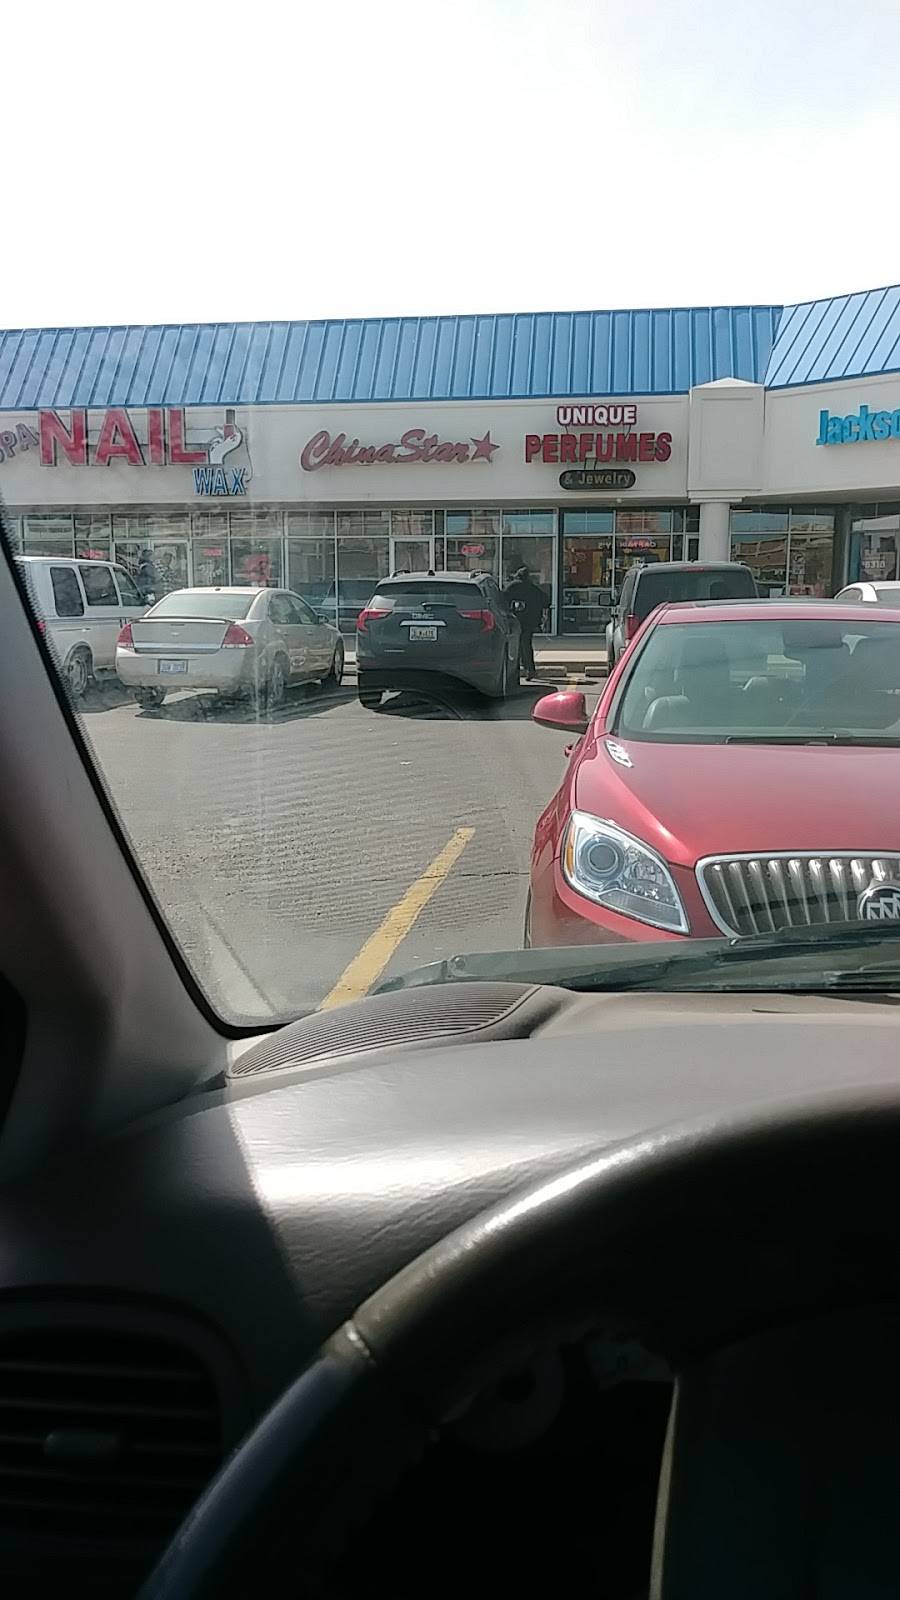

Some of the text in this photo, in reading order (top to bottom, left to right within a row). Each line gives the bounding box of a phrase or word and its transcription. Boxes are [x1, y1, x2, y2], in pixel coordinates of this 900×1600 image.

[557, 405, 638, 426] UNIQUE
[38, 408, 209, 466] NAIL
[525, 432, 673, 463] PERFUMES
[192, 467, 247, 496] WAX
[564, 472, 631, 486] & Jewelry
